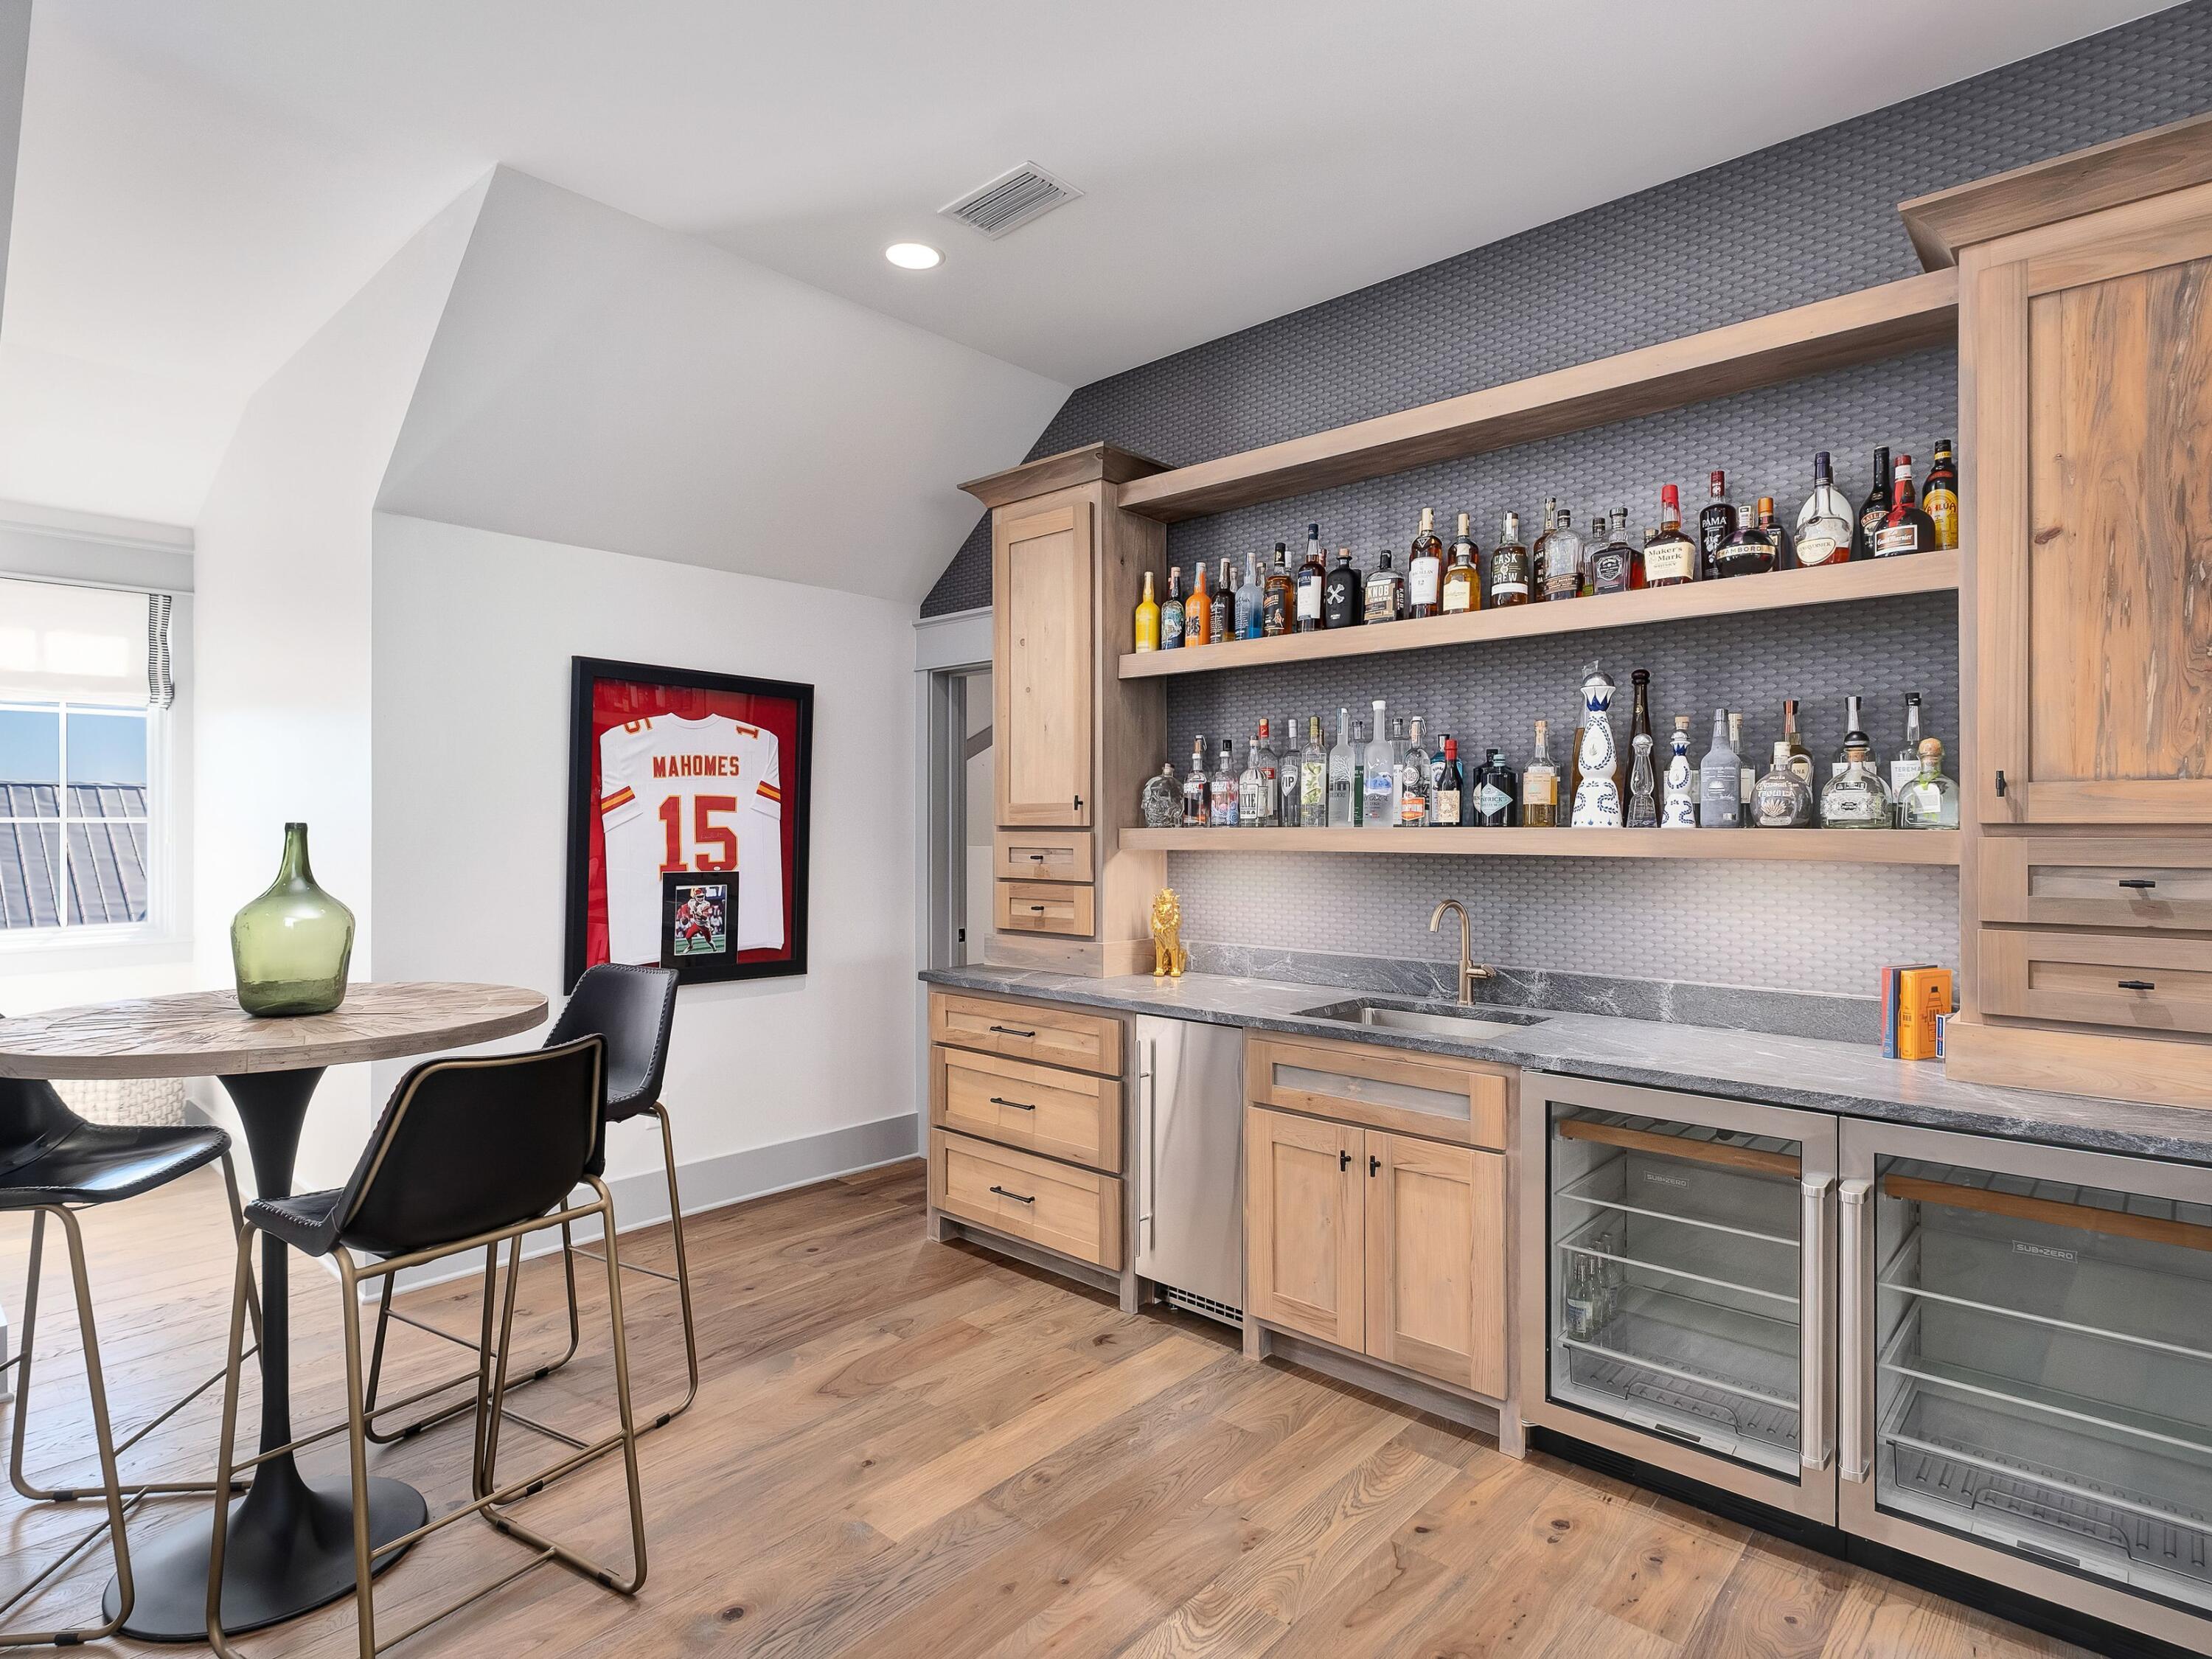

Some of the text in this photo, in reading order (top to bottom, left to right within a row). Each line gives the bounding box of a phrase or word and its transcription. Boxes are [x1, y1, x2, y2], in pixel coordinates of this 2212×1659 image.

[1703, 517, 1727, 528] PAMA
[1648, 546, 1683, 557] Maker's
[1658, 553, 1682, 562] Mark
[1717, 545, 1762, 558] CHAMBORD
[1494, 552, 1517, 566] CASK
[1493, 572, 1517, 585] CREW
[1368, 585, 1389, 599] KNOB
[653, 754, 740, 779] MAHOMES
[1239, 793, 1256, 808] IXIE
[658, 794, 738, 873] 15
